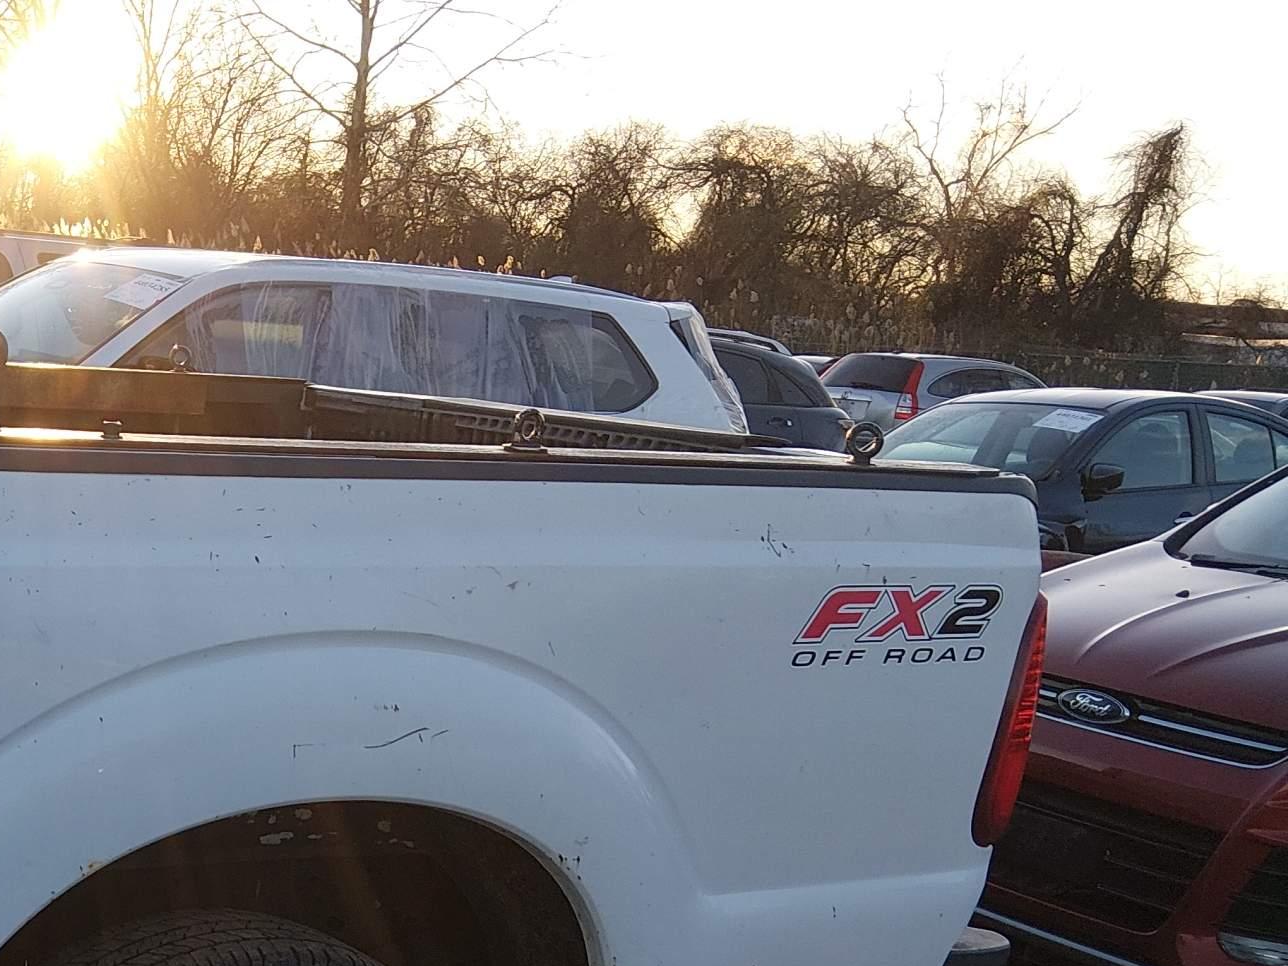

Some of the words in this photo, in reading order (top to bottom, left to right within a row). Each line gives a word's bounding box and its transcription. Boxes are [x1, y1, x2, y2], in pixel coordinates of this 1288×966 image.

[793, 584, 1003, 644] FX2
[791, 650, 866, 667] OFF
[883, 646, 985, 664] ROAD
[1069, 692, 1111, 717] Ford
